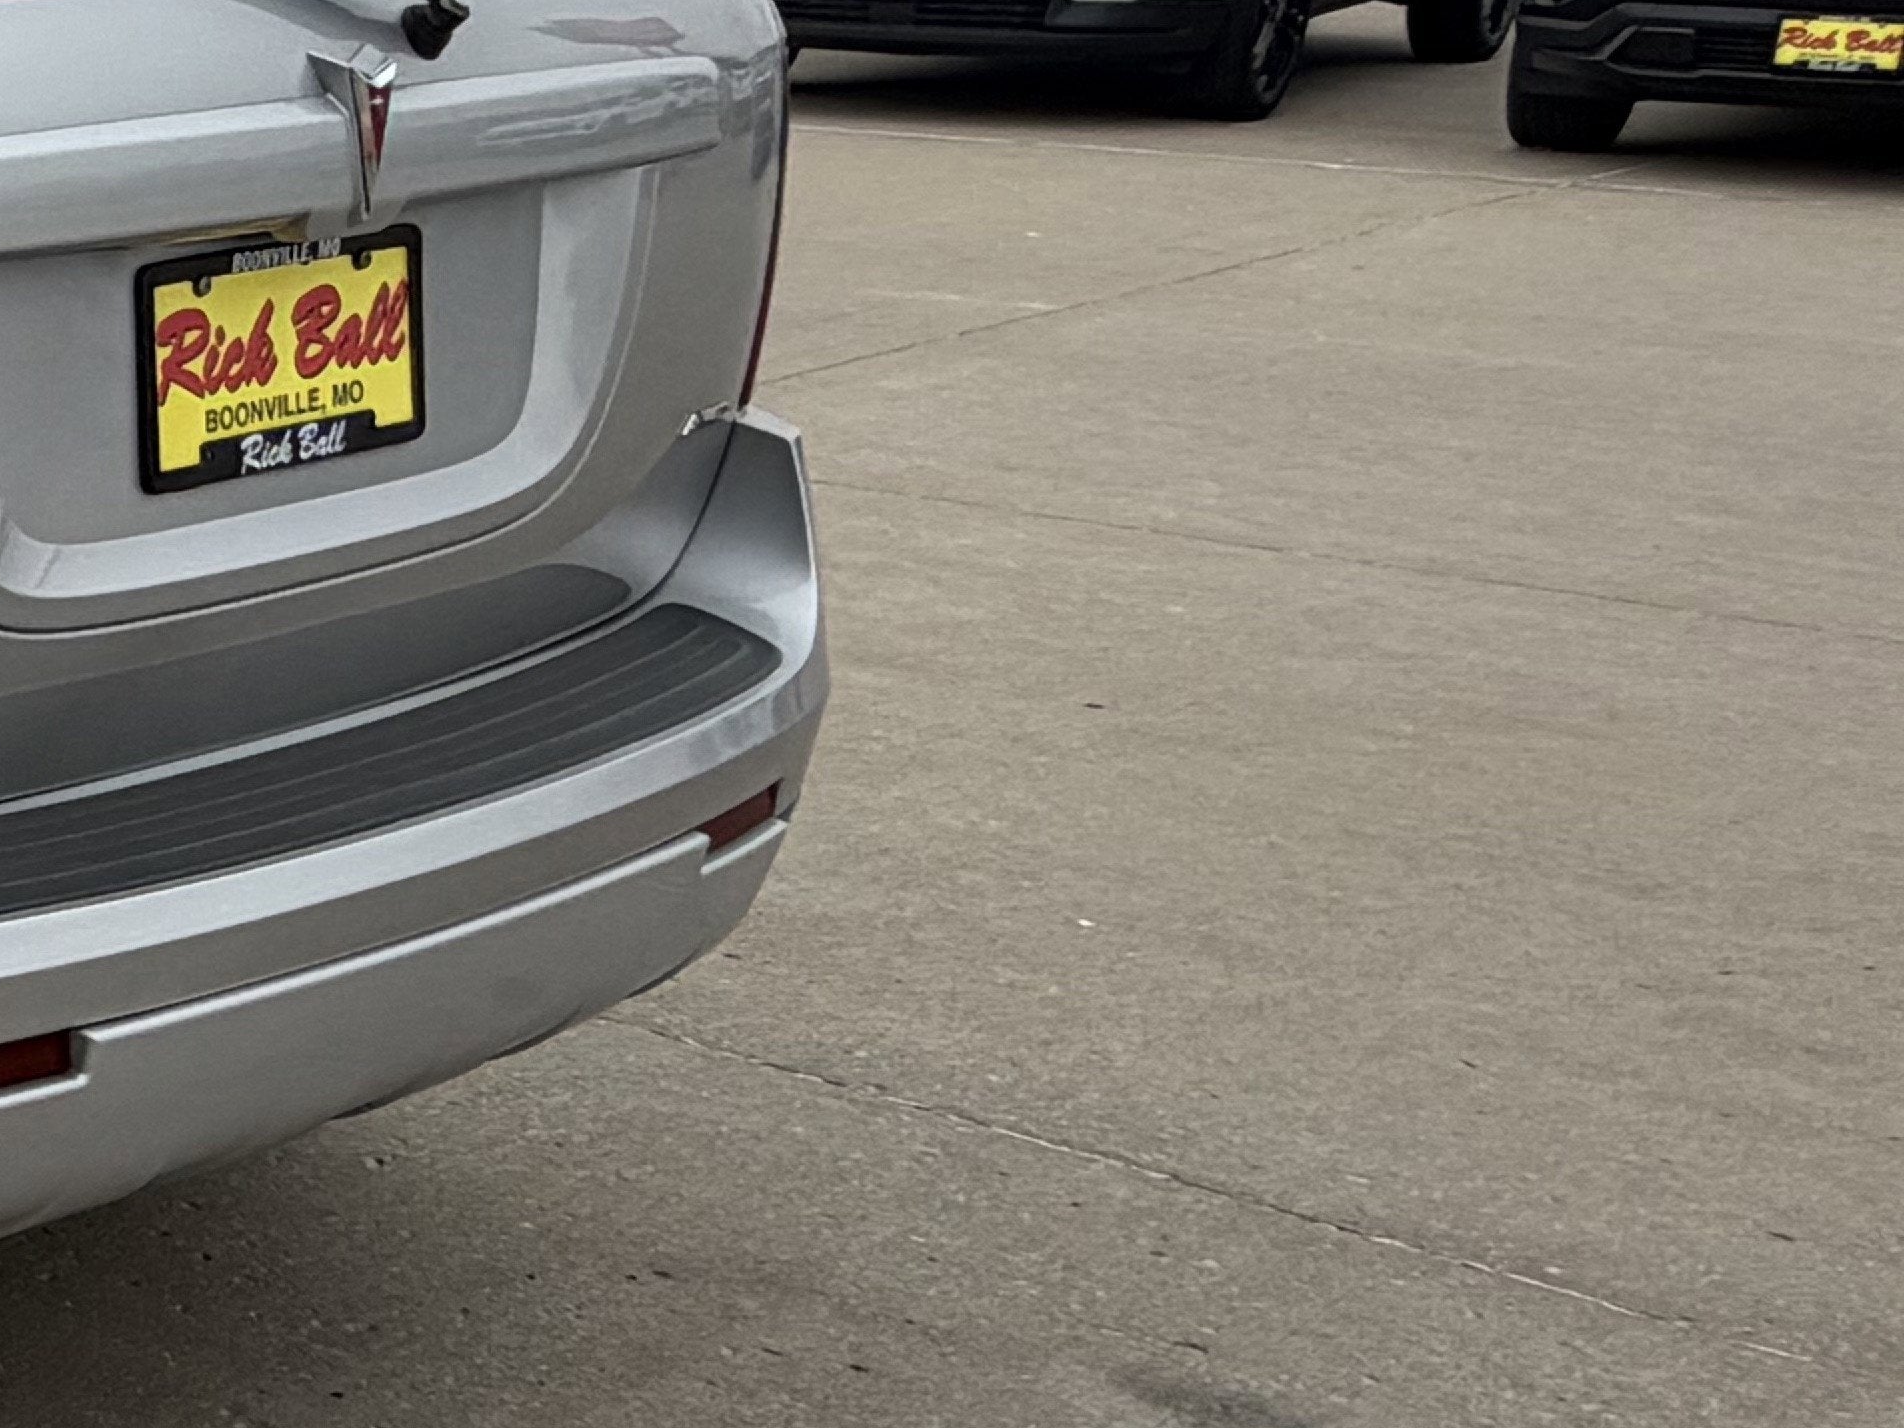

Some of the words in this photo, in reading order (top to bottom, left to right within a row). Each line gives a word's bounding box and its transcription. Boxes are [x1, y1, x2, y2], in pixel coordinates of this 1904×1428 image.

[156, 298, 277, 407] Rick
[292, 277, 409, 379] Ball
[205, 387, 327, 433] BOONVILLE,
[332, 380, 364, 406] MO
[241, 432, 292, 474] Rick
[297, 420, 346, 460] Ball
